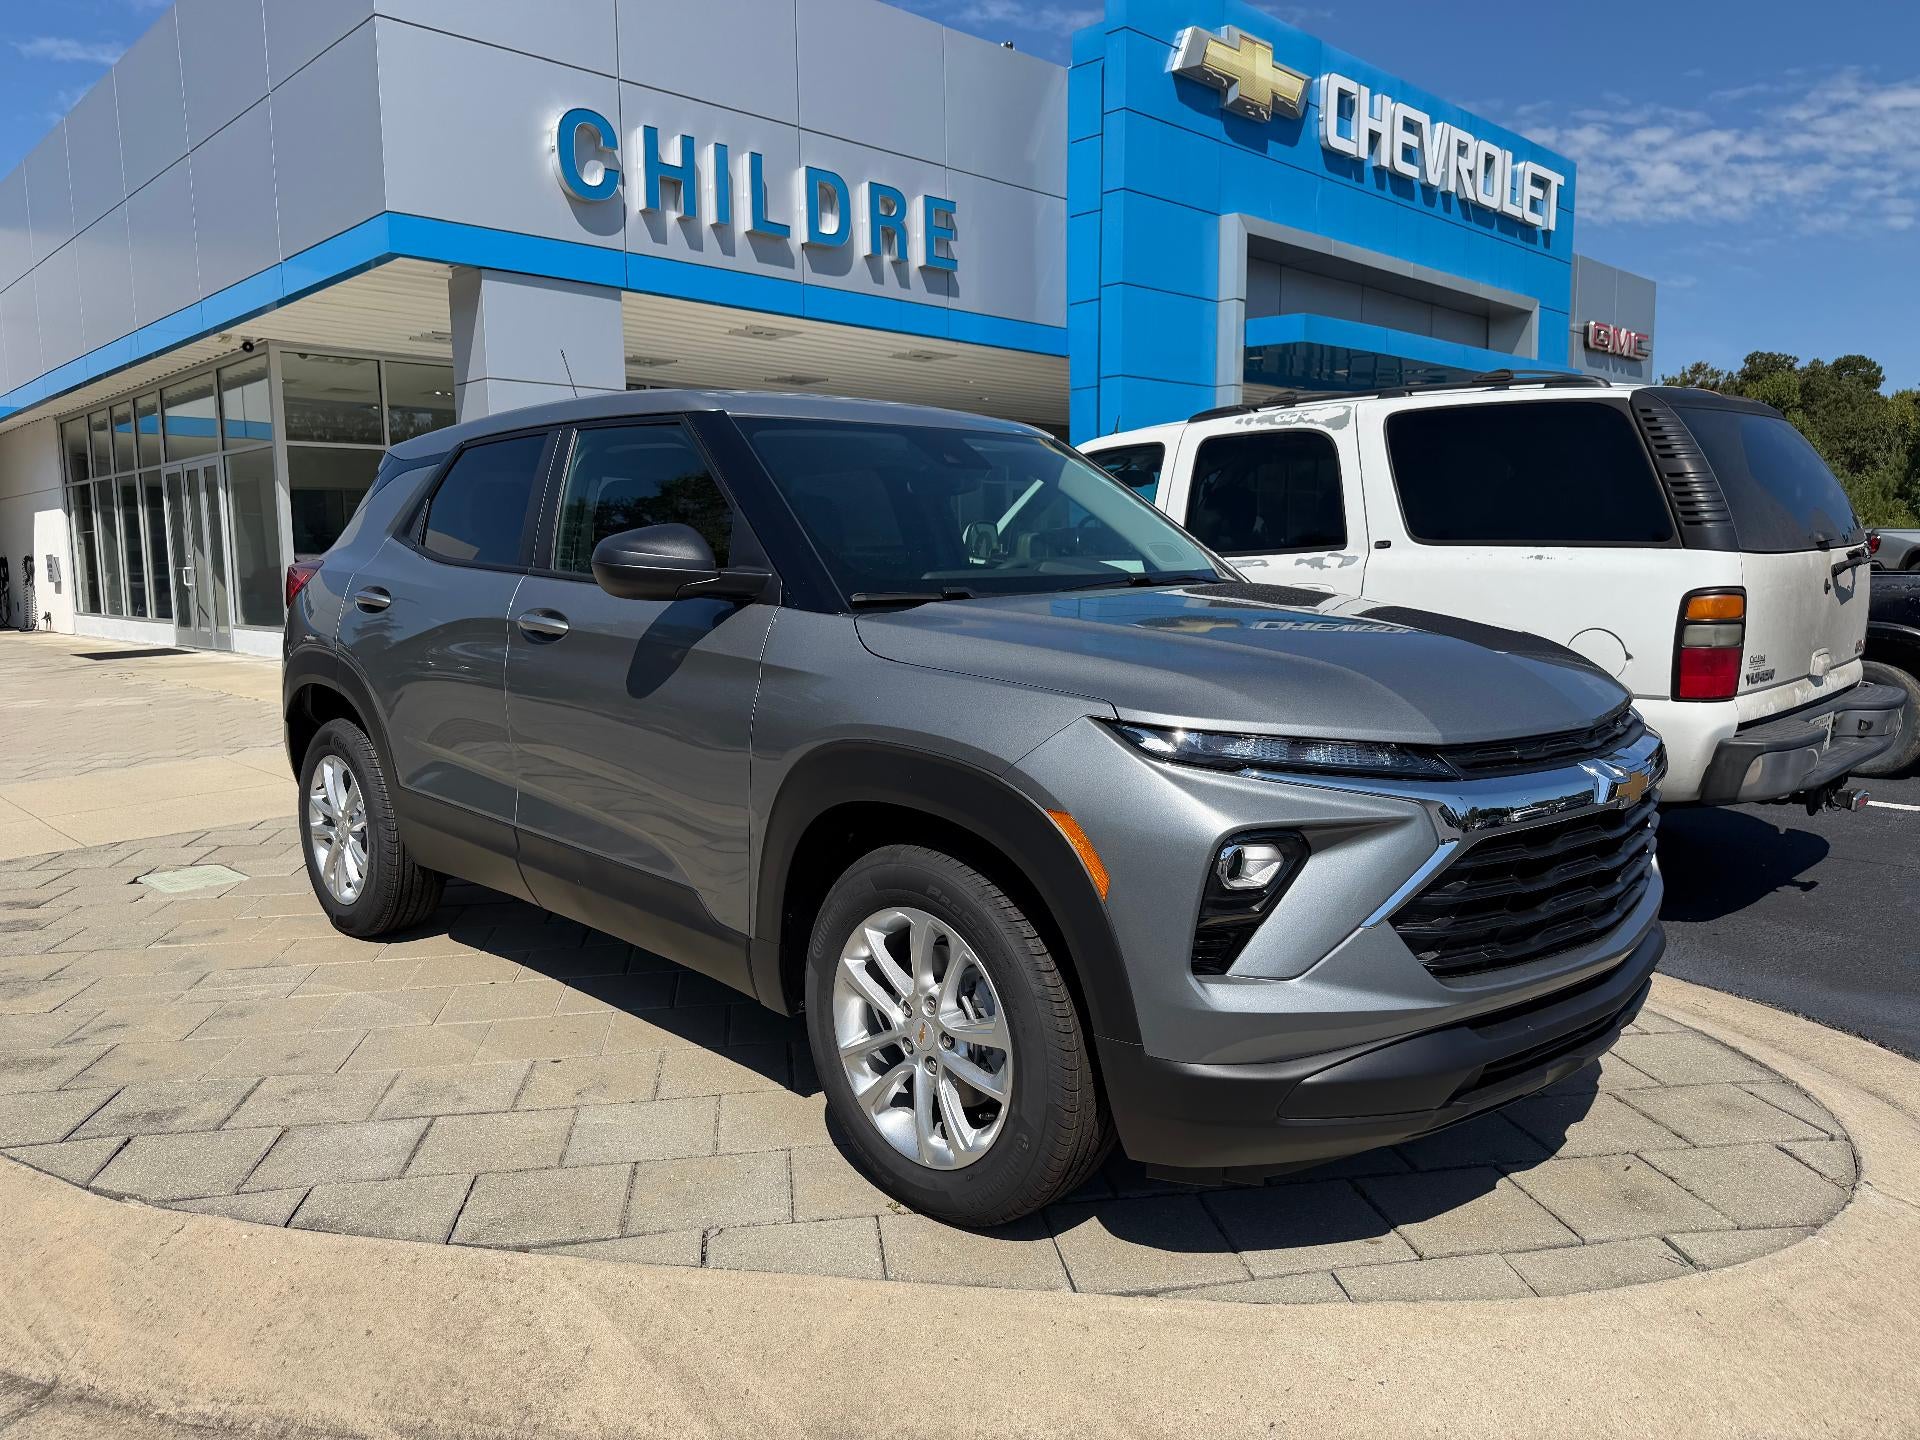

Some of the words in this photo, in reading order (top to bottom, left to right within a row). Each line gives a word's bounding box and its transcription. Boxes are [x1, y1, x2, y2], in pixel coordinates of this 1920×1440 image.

[551, 107, 958, 273] CHILDRE
[1319, 71, 1565, 232] CHEVROLET
[1583, 320, 1649, 361] GMC
